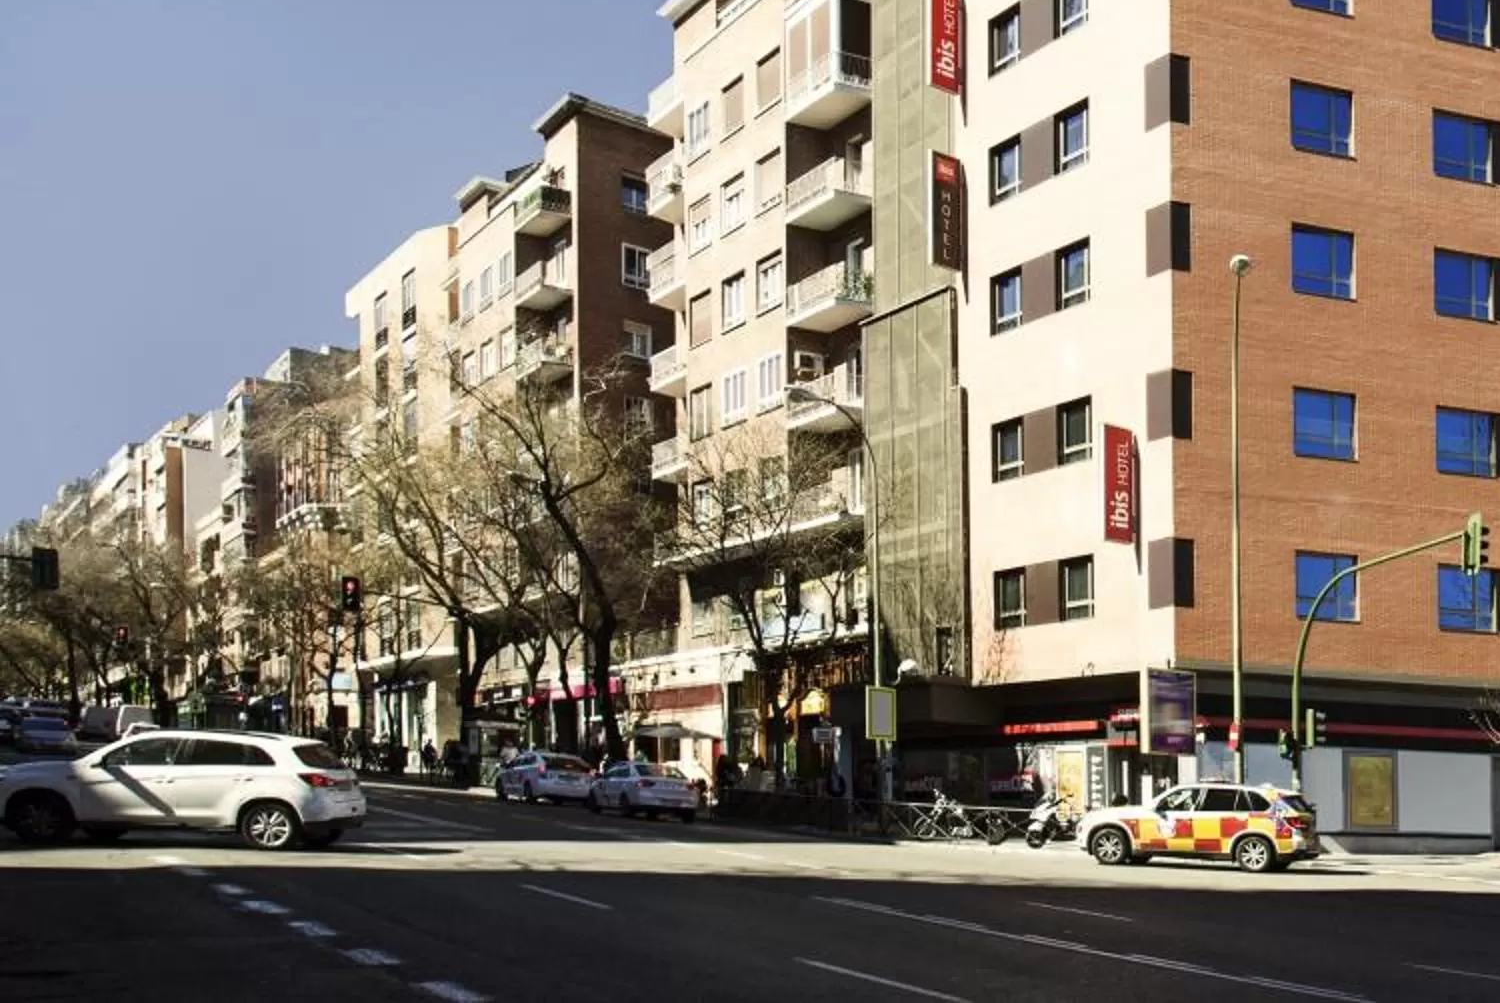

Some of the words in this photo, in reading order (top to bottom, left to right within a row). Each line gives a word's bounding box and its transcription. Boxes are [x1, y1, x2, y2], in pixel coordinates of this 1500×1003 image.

[936, 38, 955, 79] ibis
[941, 190, 953, 260] HOTEL
[1116, 440, 1129, 486] HOTEL
[1109, 491, 1129, 529] ibis
